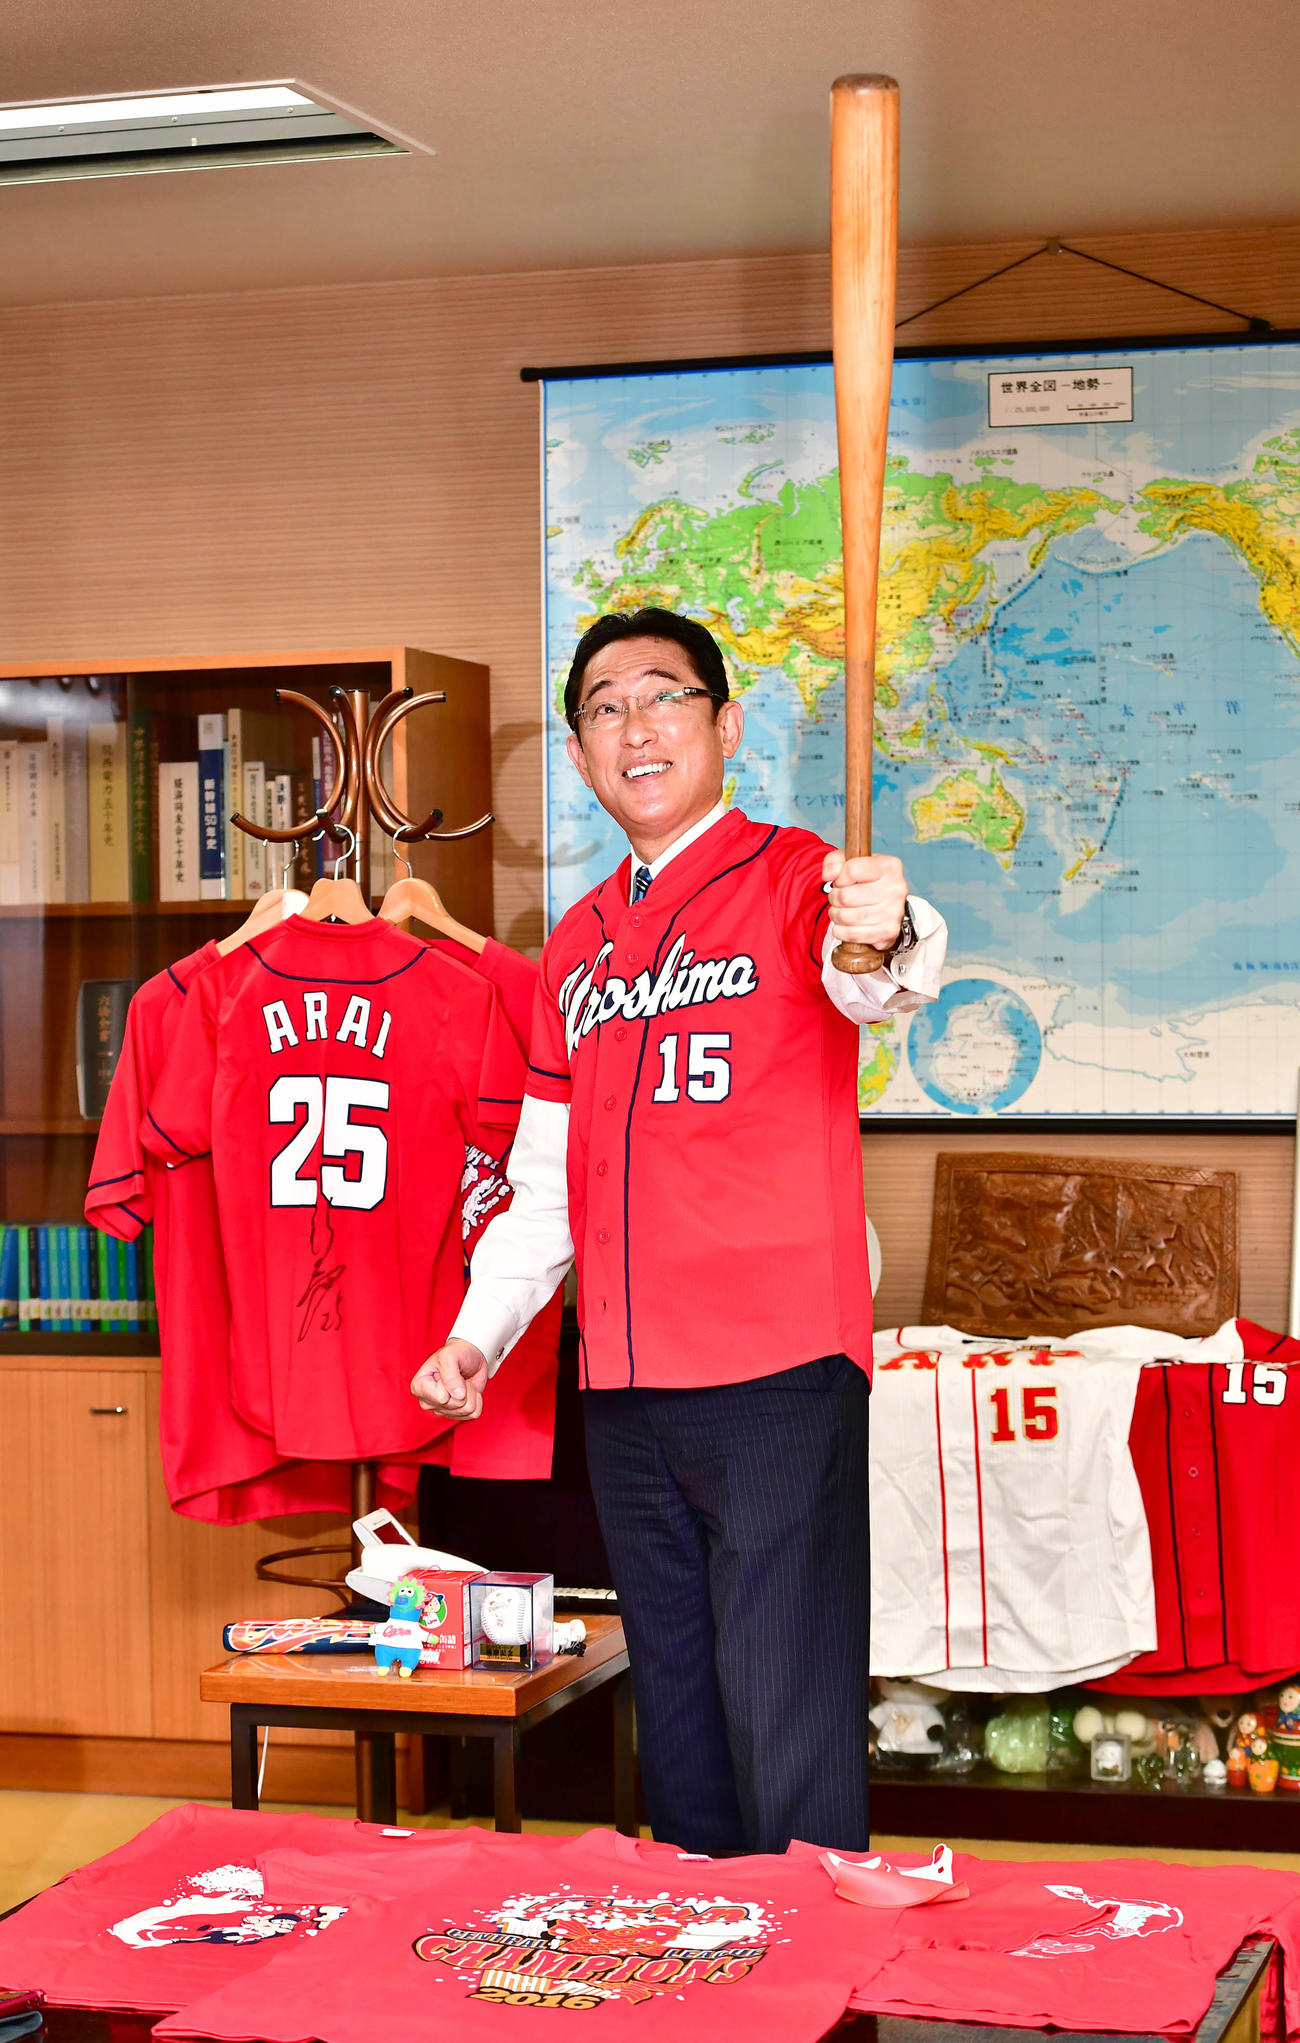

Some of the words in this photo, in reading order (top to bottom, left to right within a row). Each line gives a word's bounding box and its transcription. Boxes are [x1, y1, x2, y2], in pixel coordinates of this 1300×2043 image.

[203, 778, 218, 851] 新幹線50年史
[262, 990, 392, 1060] ARAI
[558, 931, 760, 1062] Hroshima
[652, 1031, 732, 1104] 15
[268, 1074, 391, 1212] 25
[988, 1384, 1060, 1445] 15
[1221, 1362, 1289, 1407] 15
[412, 1935, 767, 1985] CHAMPIONS
[446, 1927, 548, 1950] CENTRAL
[662, 1946, 768, 1959] LEAGUE
[468, 1986, 603, 2010] 2016
